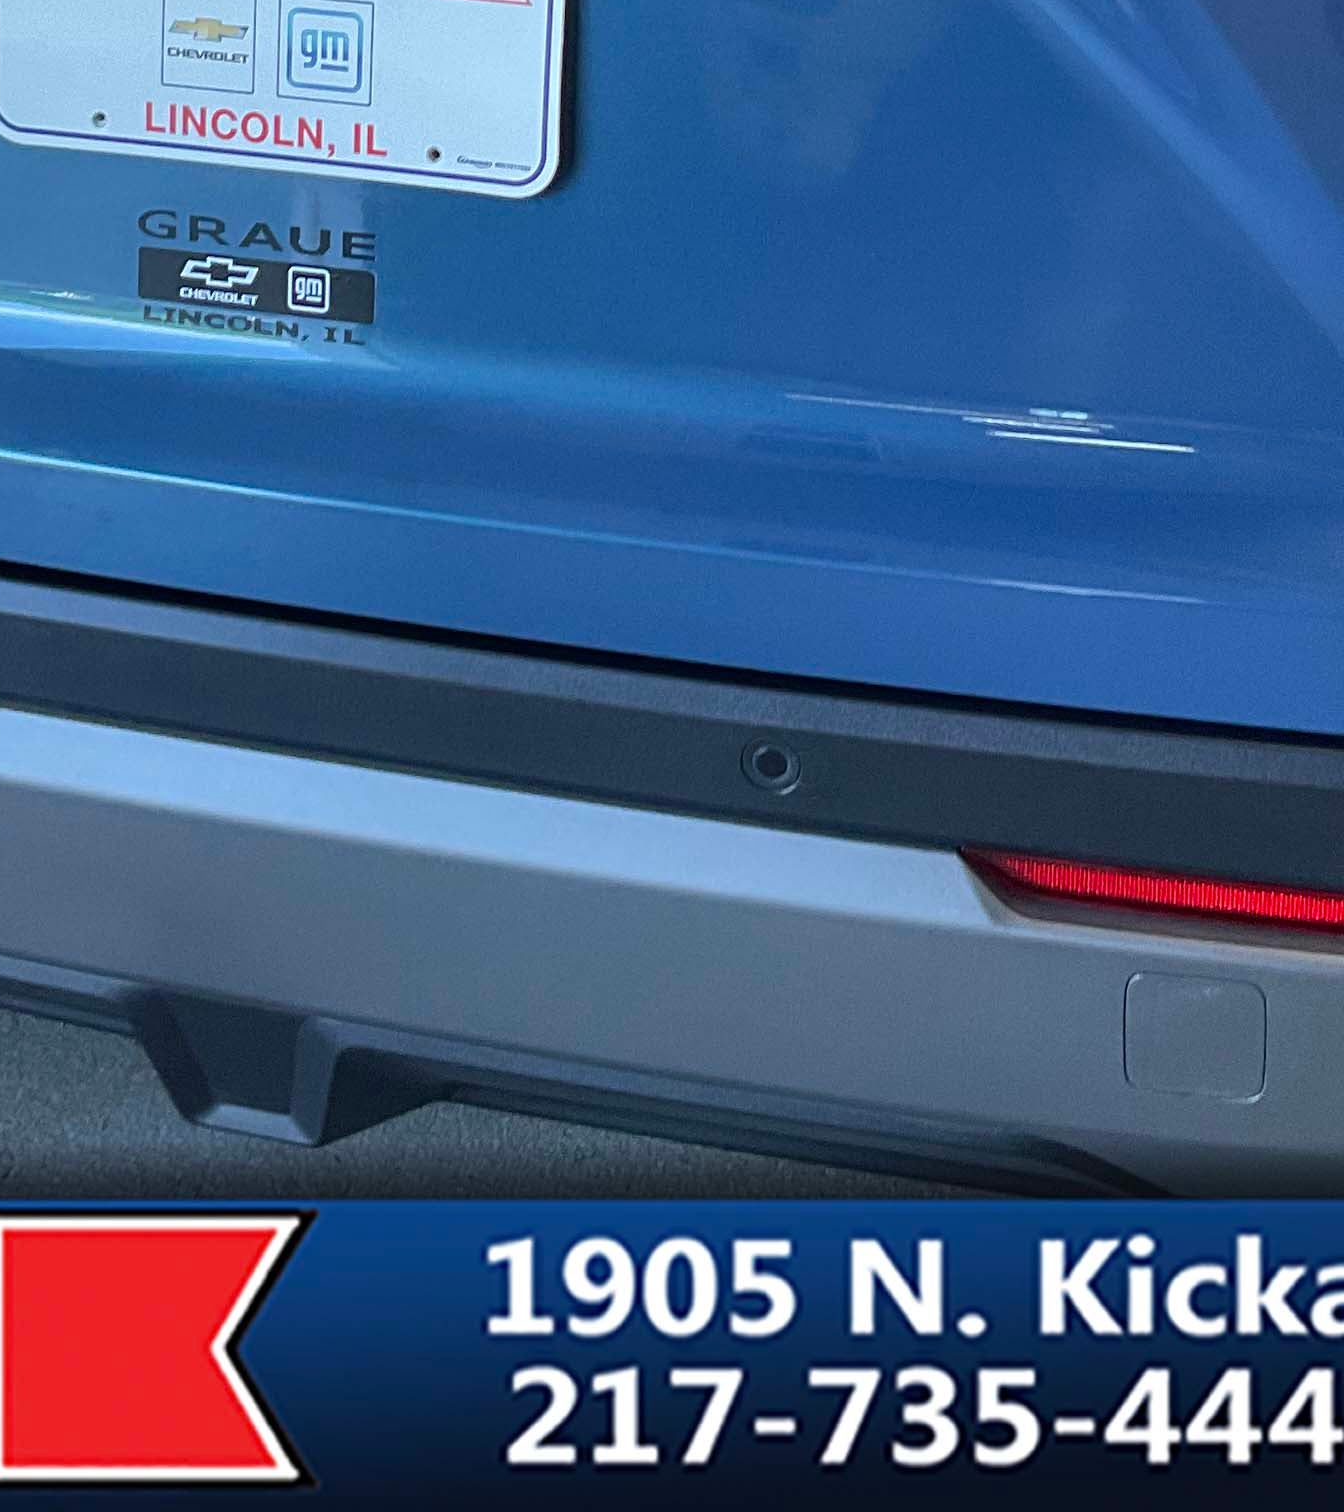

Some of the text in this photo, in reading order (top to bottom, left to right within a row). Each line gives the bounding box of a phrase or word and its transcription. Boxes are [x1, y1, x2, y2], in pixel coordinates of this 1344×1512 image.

[167, 46, 249, 65] CHEVROLET
[300, 29, 350, 72] gm
[145, 101, 388, 157] LINCOLN, IL
[138, 209, 376, 262] GRAUE
[179, 286, 259, 307] CHEVROLET
[294, 276, 323, 303] gm
[143, 304, 367, 346] LINCOLN, IL
